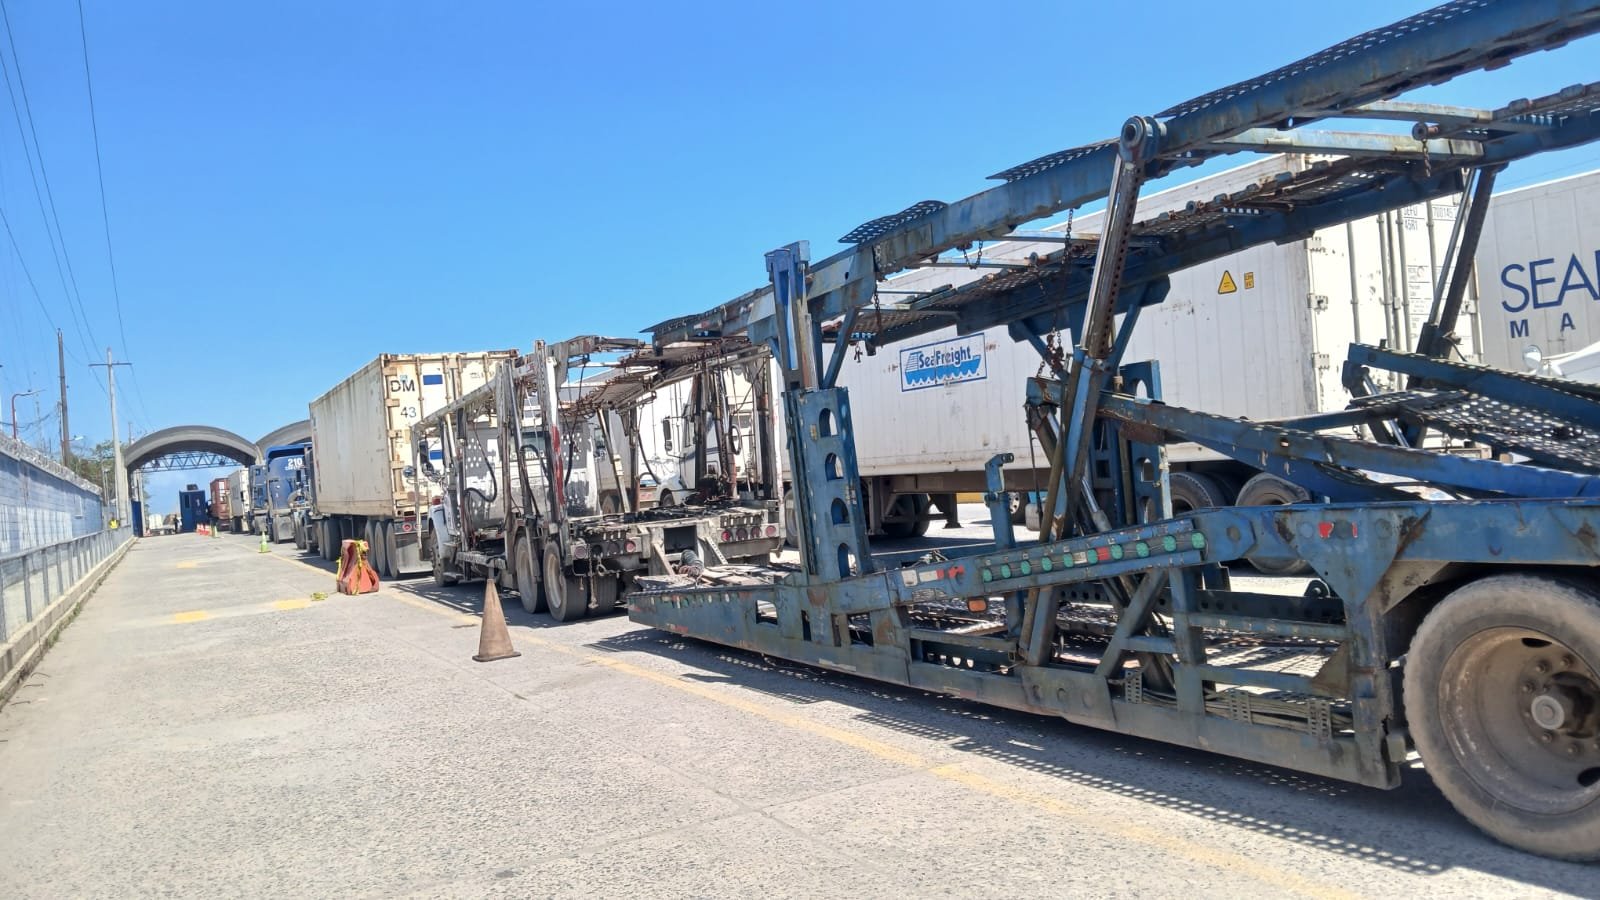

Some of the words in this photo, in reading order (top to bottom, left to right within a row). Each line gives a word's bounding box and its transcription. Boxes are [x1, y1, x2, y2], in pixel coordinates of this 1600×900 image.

[390, 379, 416, 392] DM
[400, 406, 417, 418] 43
[287, 457, 303, 467] 210
